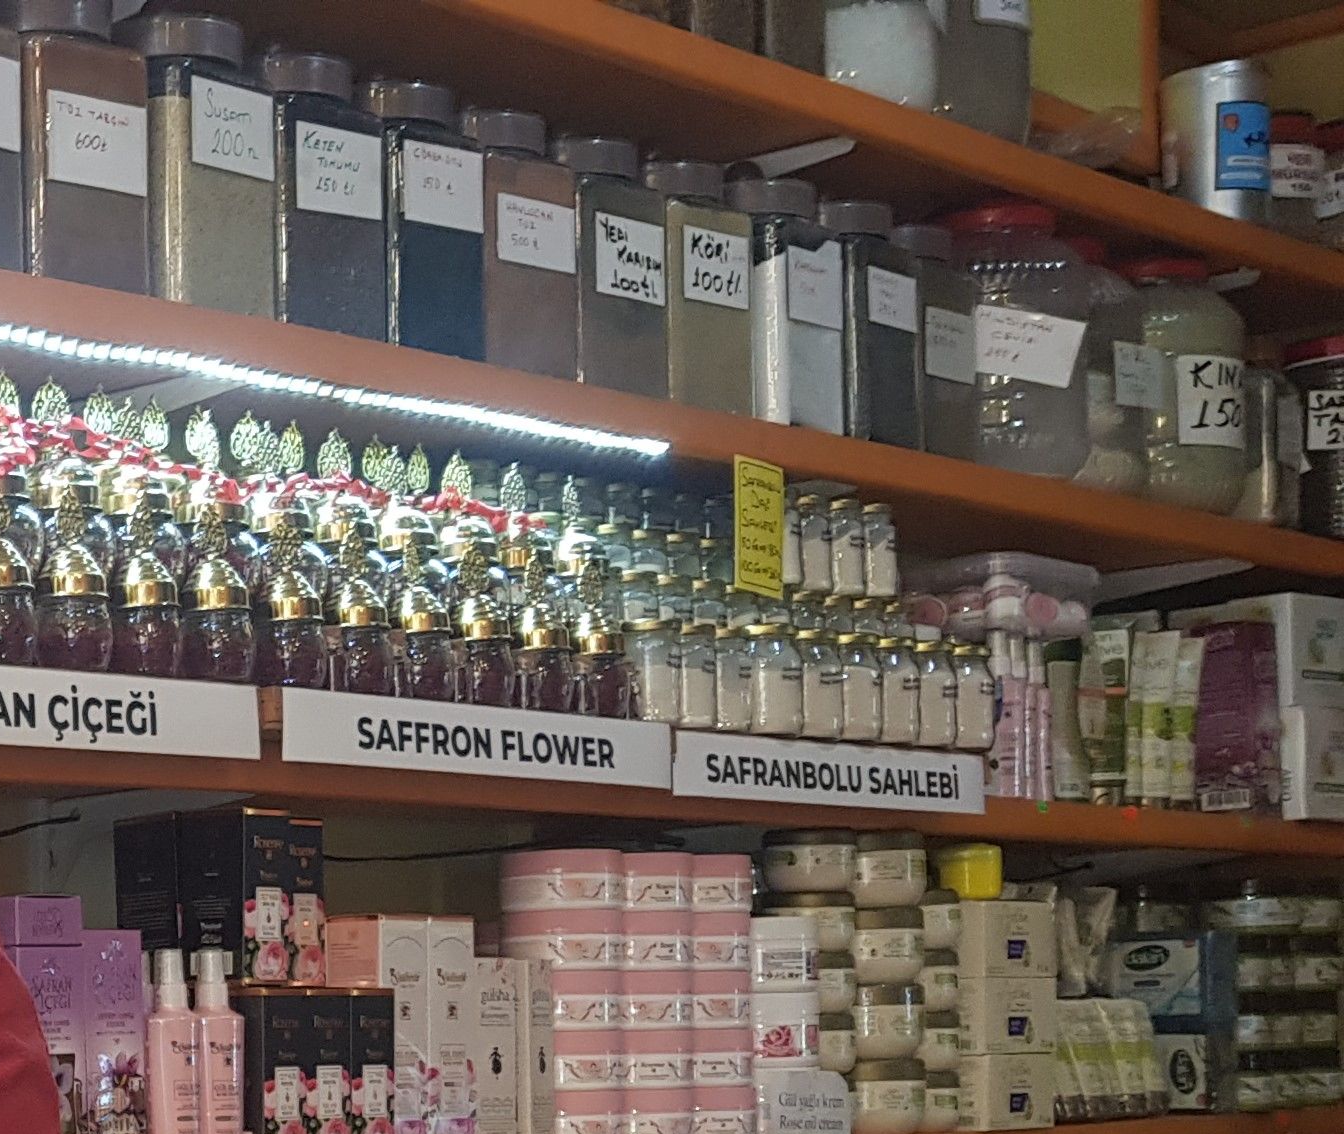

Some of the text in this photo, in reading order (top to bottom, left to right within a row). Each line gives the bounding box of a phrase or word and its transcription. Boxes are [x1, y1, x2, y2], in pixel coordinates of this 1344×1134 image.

[211, 128, 244, 157] 200
[302, 130, 345, 153] KETEN
[1189, 360, 1243, 389] KIN
[47, 684, 158, 743] ÇİÇEĞİ
[357, 716, 615, 769] SAFFRON FLOWER
[706, 753, 960, 800] SAFRANBOLU SAHLEBİ
